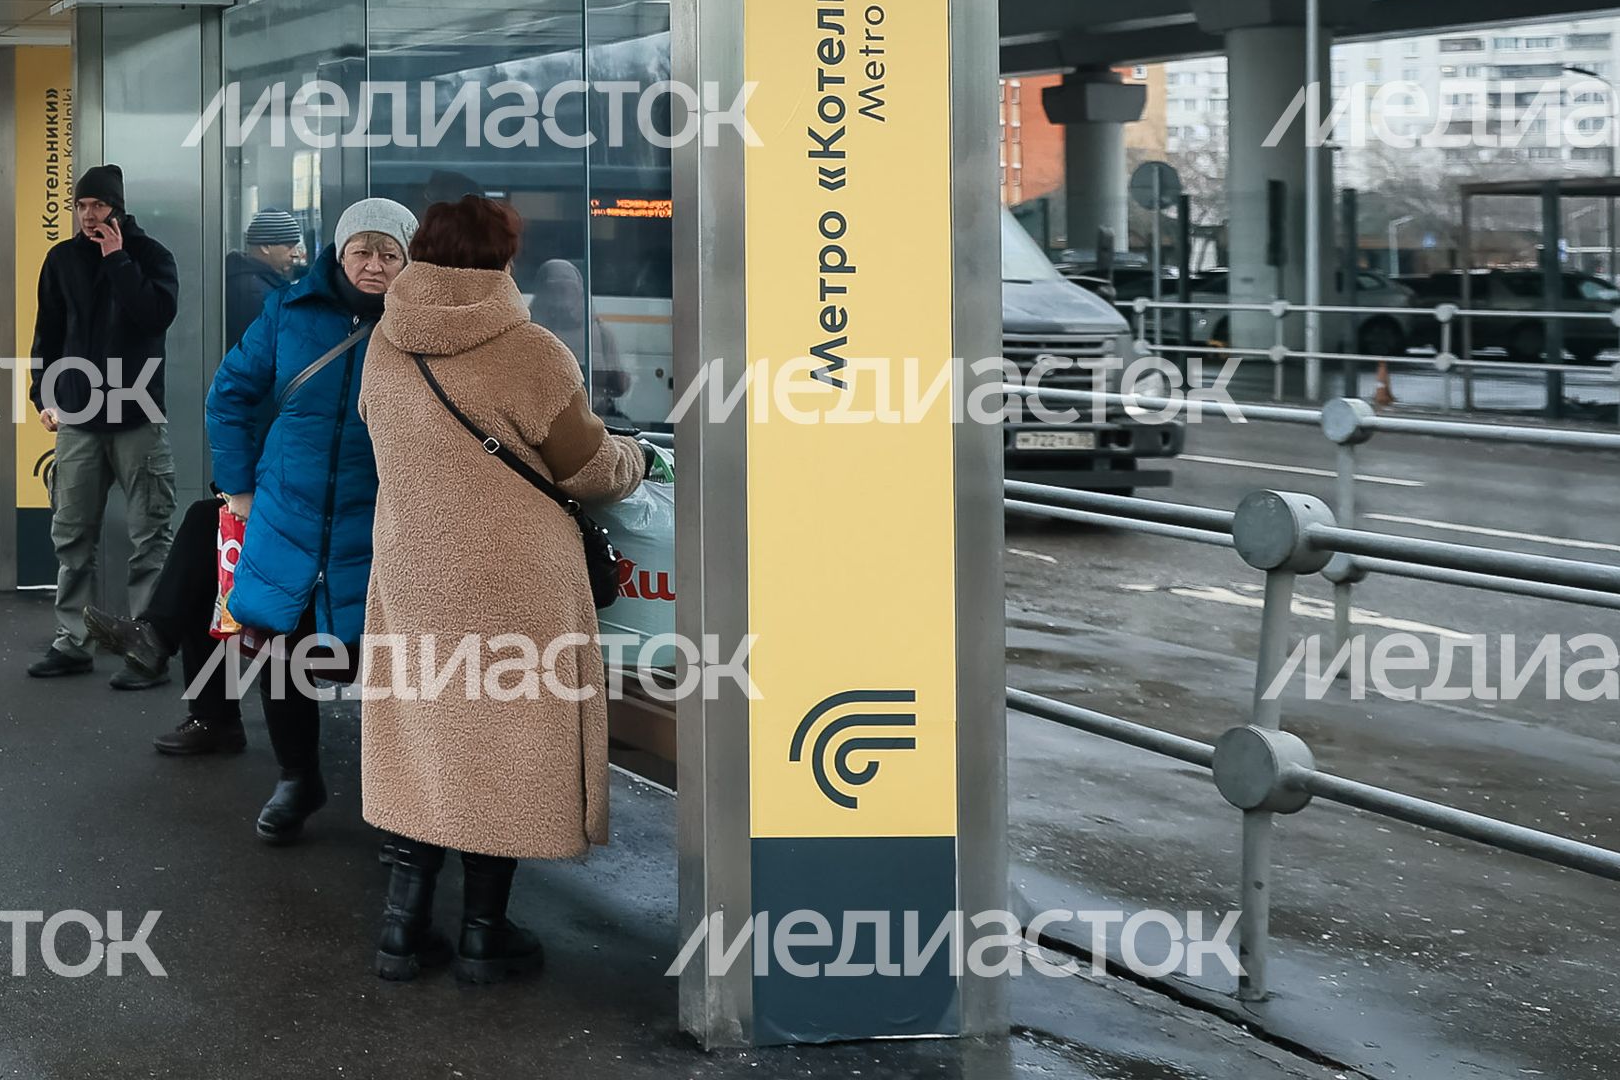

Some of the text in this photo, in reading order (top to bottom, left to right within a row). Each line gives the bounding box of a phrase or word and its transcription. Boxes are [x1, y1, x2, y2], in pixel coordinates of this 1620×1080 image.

[857, 4, 886, 123] Metro
[42, 88, 59, 242] «Котельники»
[809, 210, 856, 390] Метро
